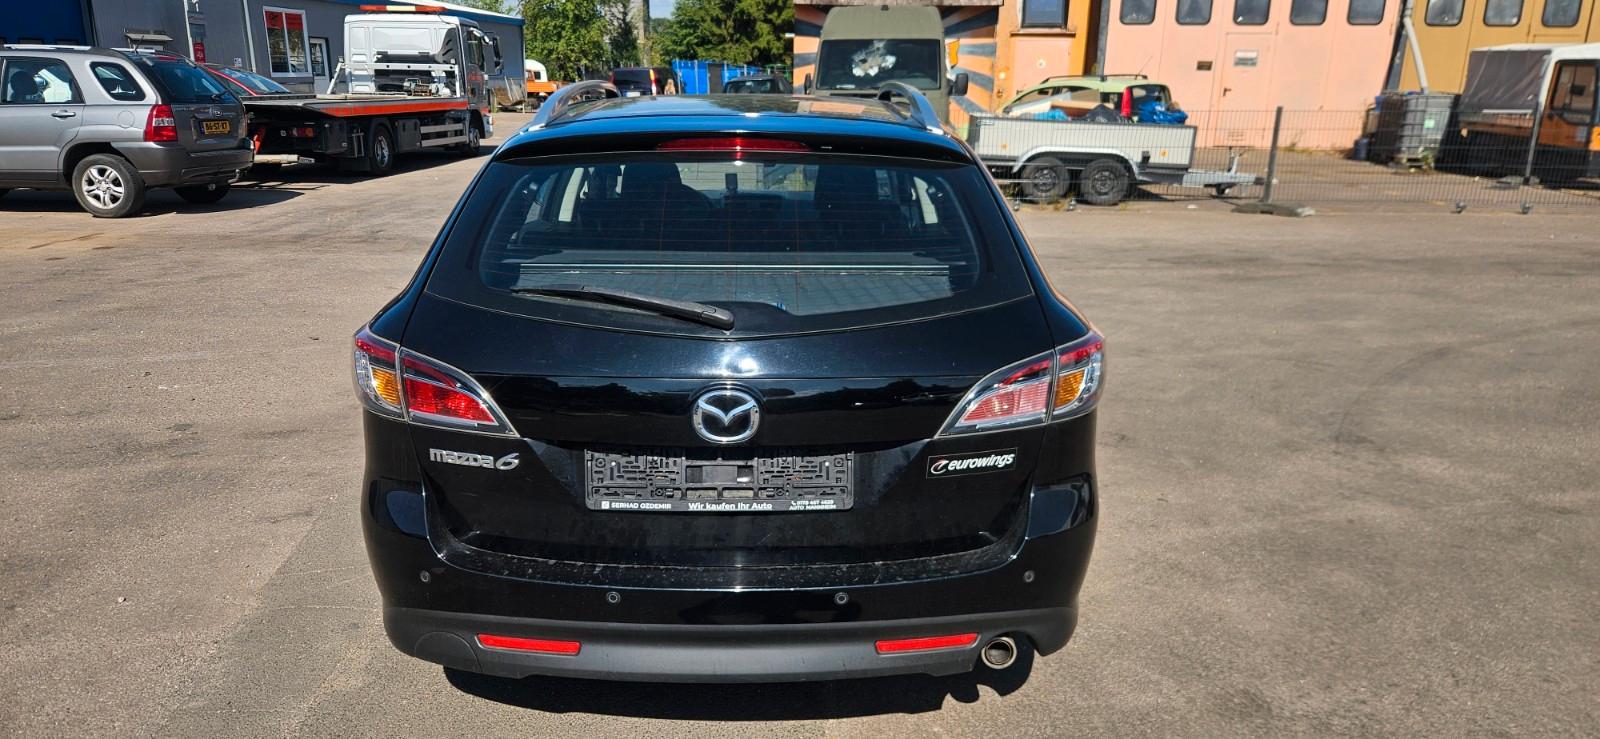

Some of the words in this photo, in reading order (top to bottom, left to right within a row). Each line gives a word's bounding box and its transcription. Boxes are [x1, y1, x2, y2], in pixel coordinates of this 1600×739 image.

[947, 453, 1016, 471] eurowings
[688, 502, 704, 510] Wir
[705, 502, 736, 510] kaufen
[737, 502, 750, 510] Ihr
[751, 502, 773, 510] Auto
